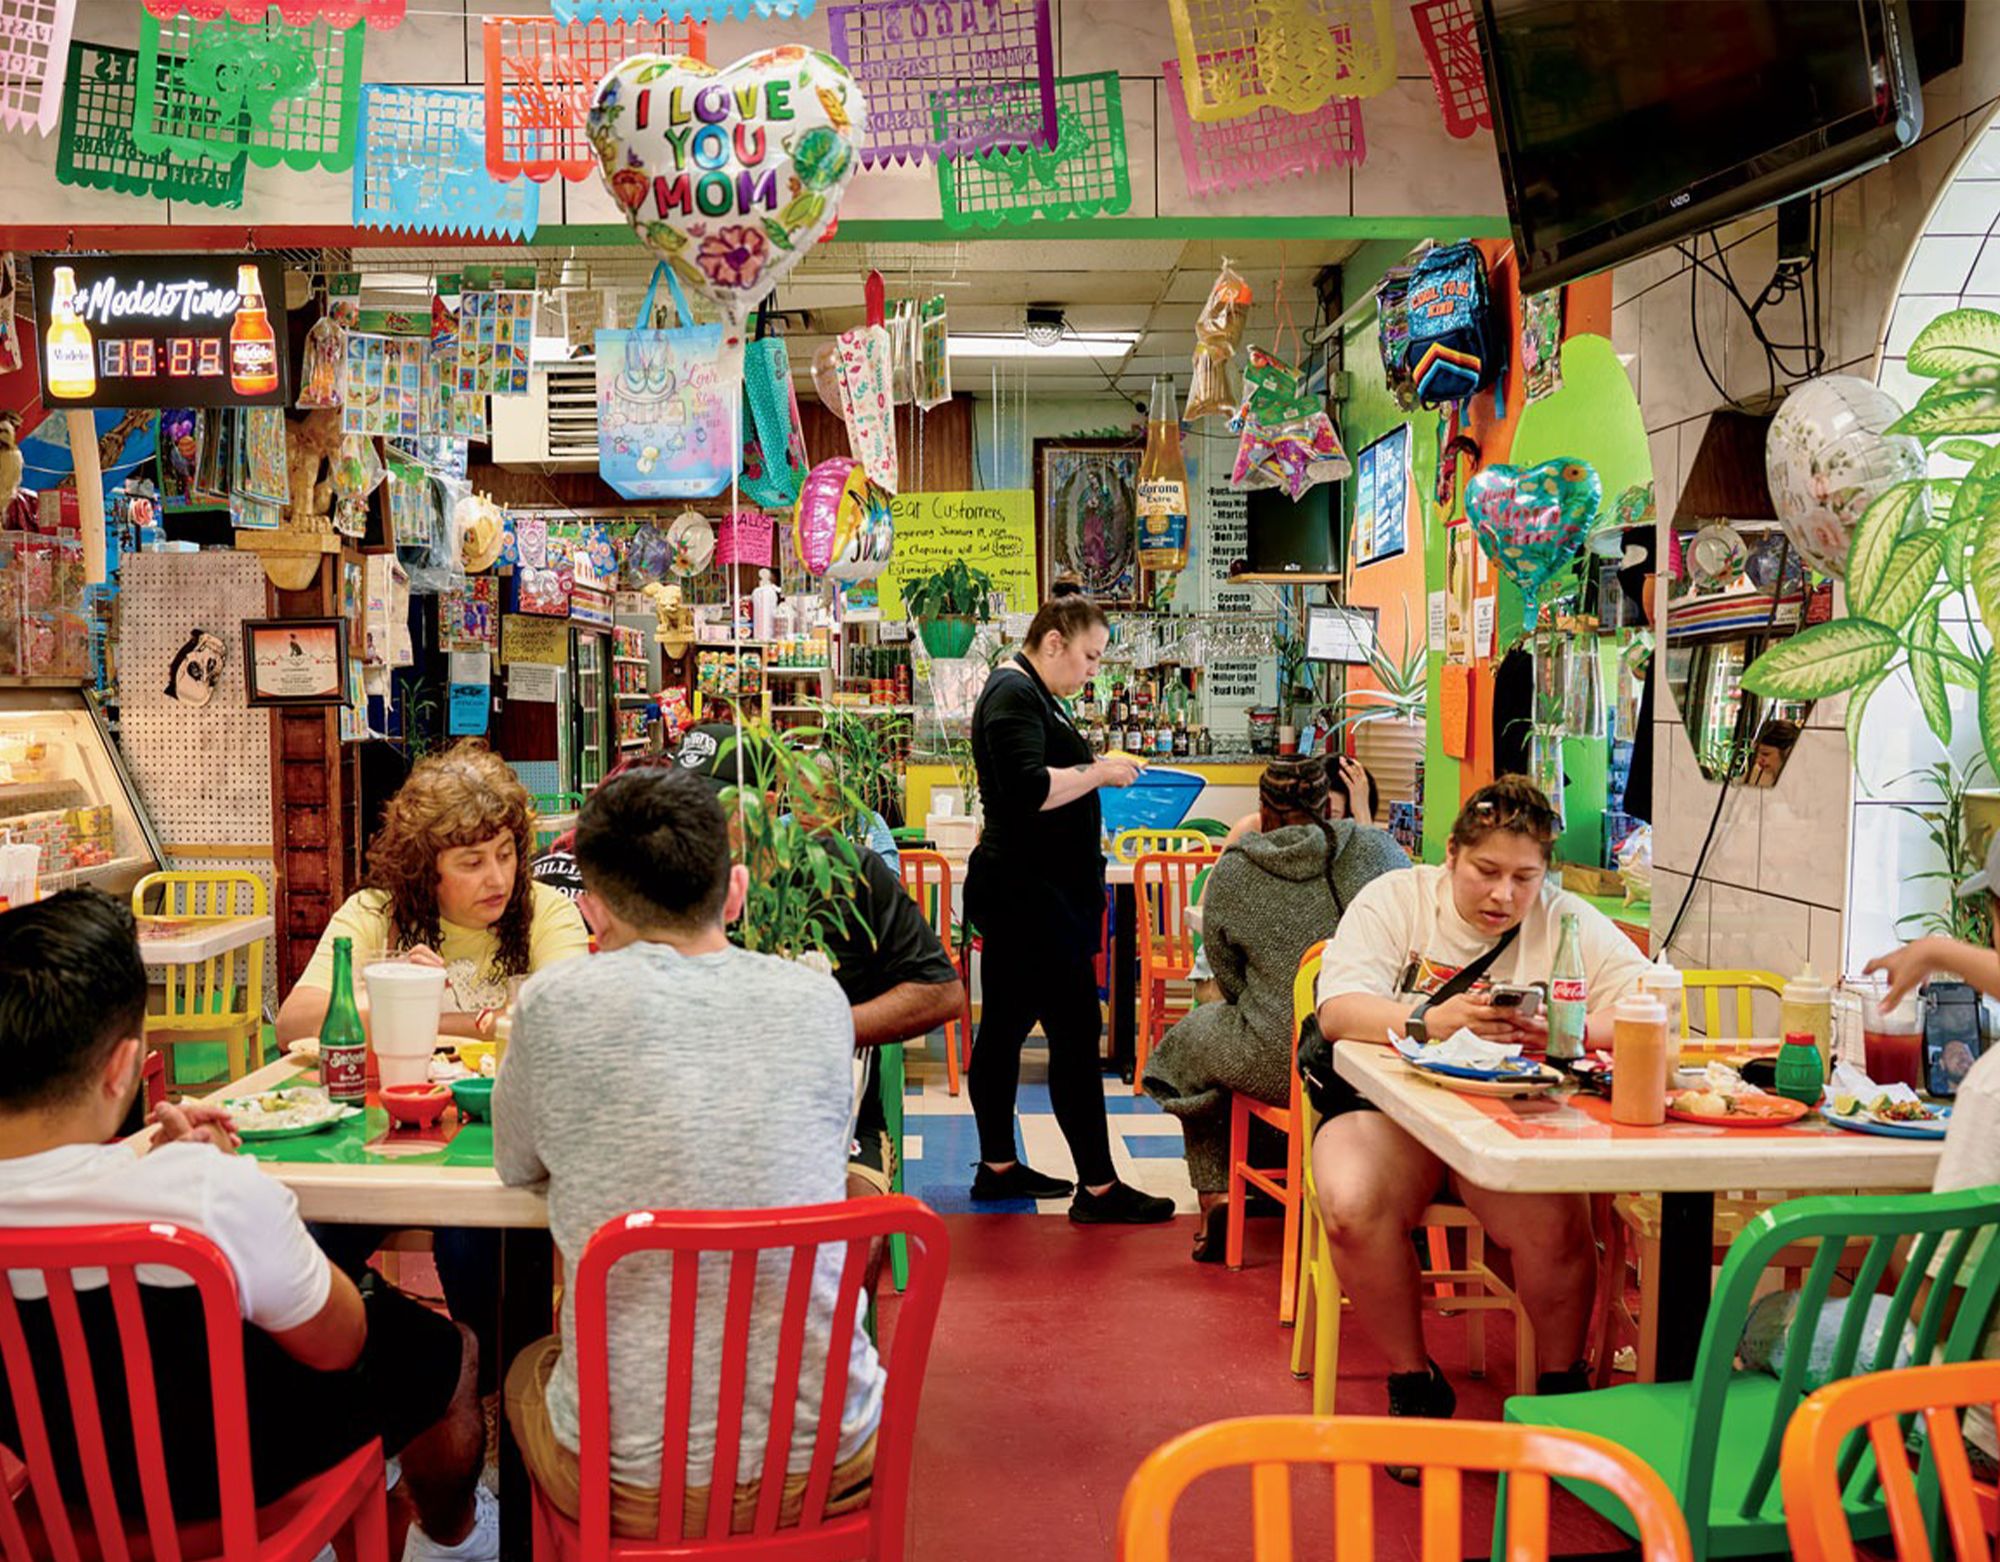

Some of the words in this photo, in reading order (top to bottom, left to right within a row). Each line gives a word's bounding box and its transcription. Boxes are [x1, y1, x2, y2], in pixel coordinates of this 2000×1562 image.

[636, 89, 651, 129] I
[669, 80, 795, 127] LOVE
[664, 122, 766, 171] YOU
[652, 168, 778, 219] MOM
[1411, 287, 1439, 310] COOL
[1443, 280, 1457, 296] TO
[1138, 484, 1179, 496] Corona
[891, 499, 921, 519] ear
[1217, 592, 1250, 602] Corona
[1217, 603, 1251, 612] Modelo
[1214, 662, 1257, 671] Budweiser
[1237, 672, 1257, 682] Light
[1213, 686, 1231, 695] Bud
[1232, 685, 1255, 696] Light
